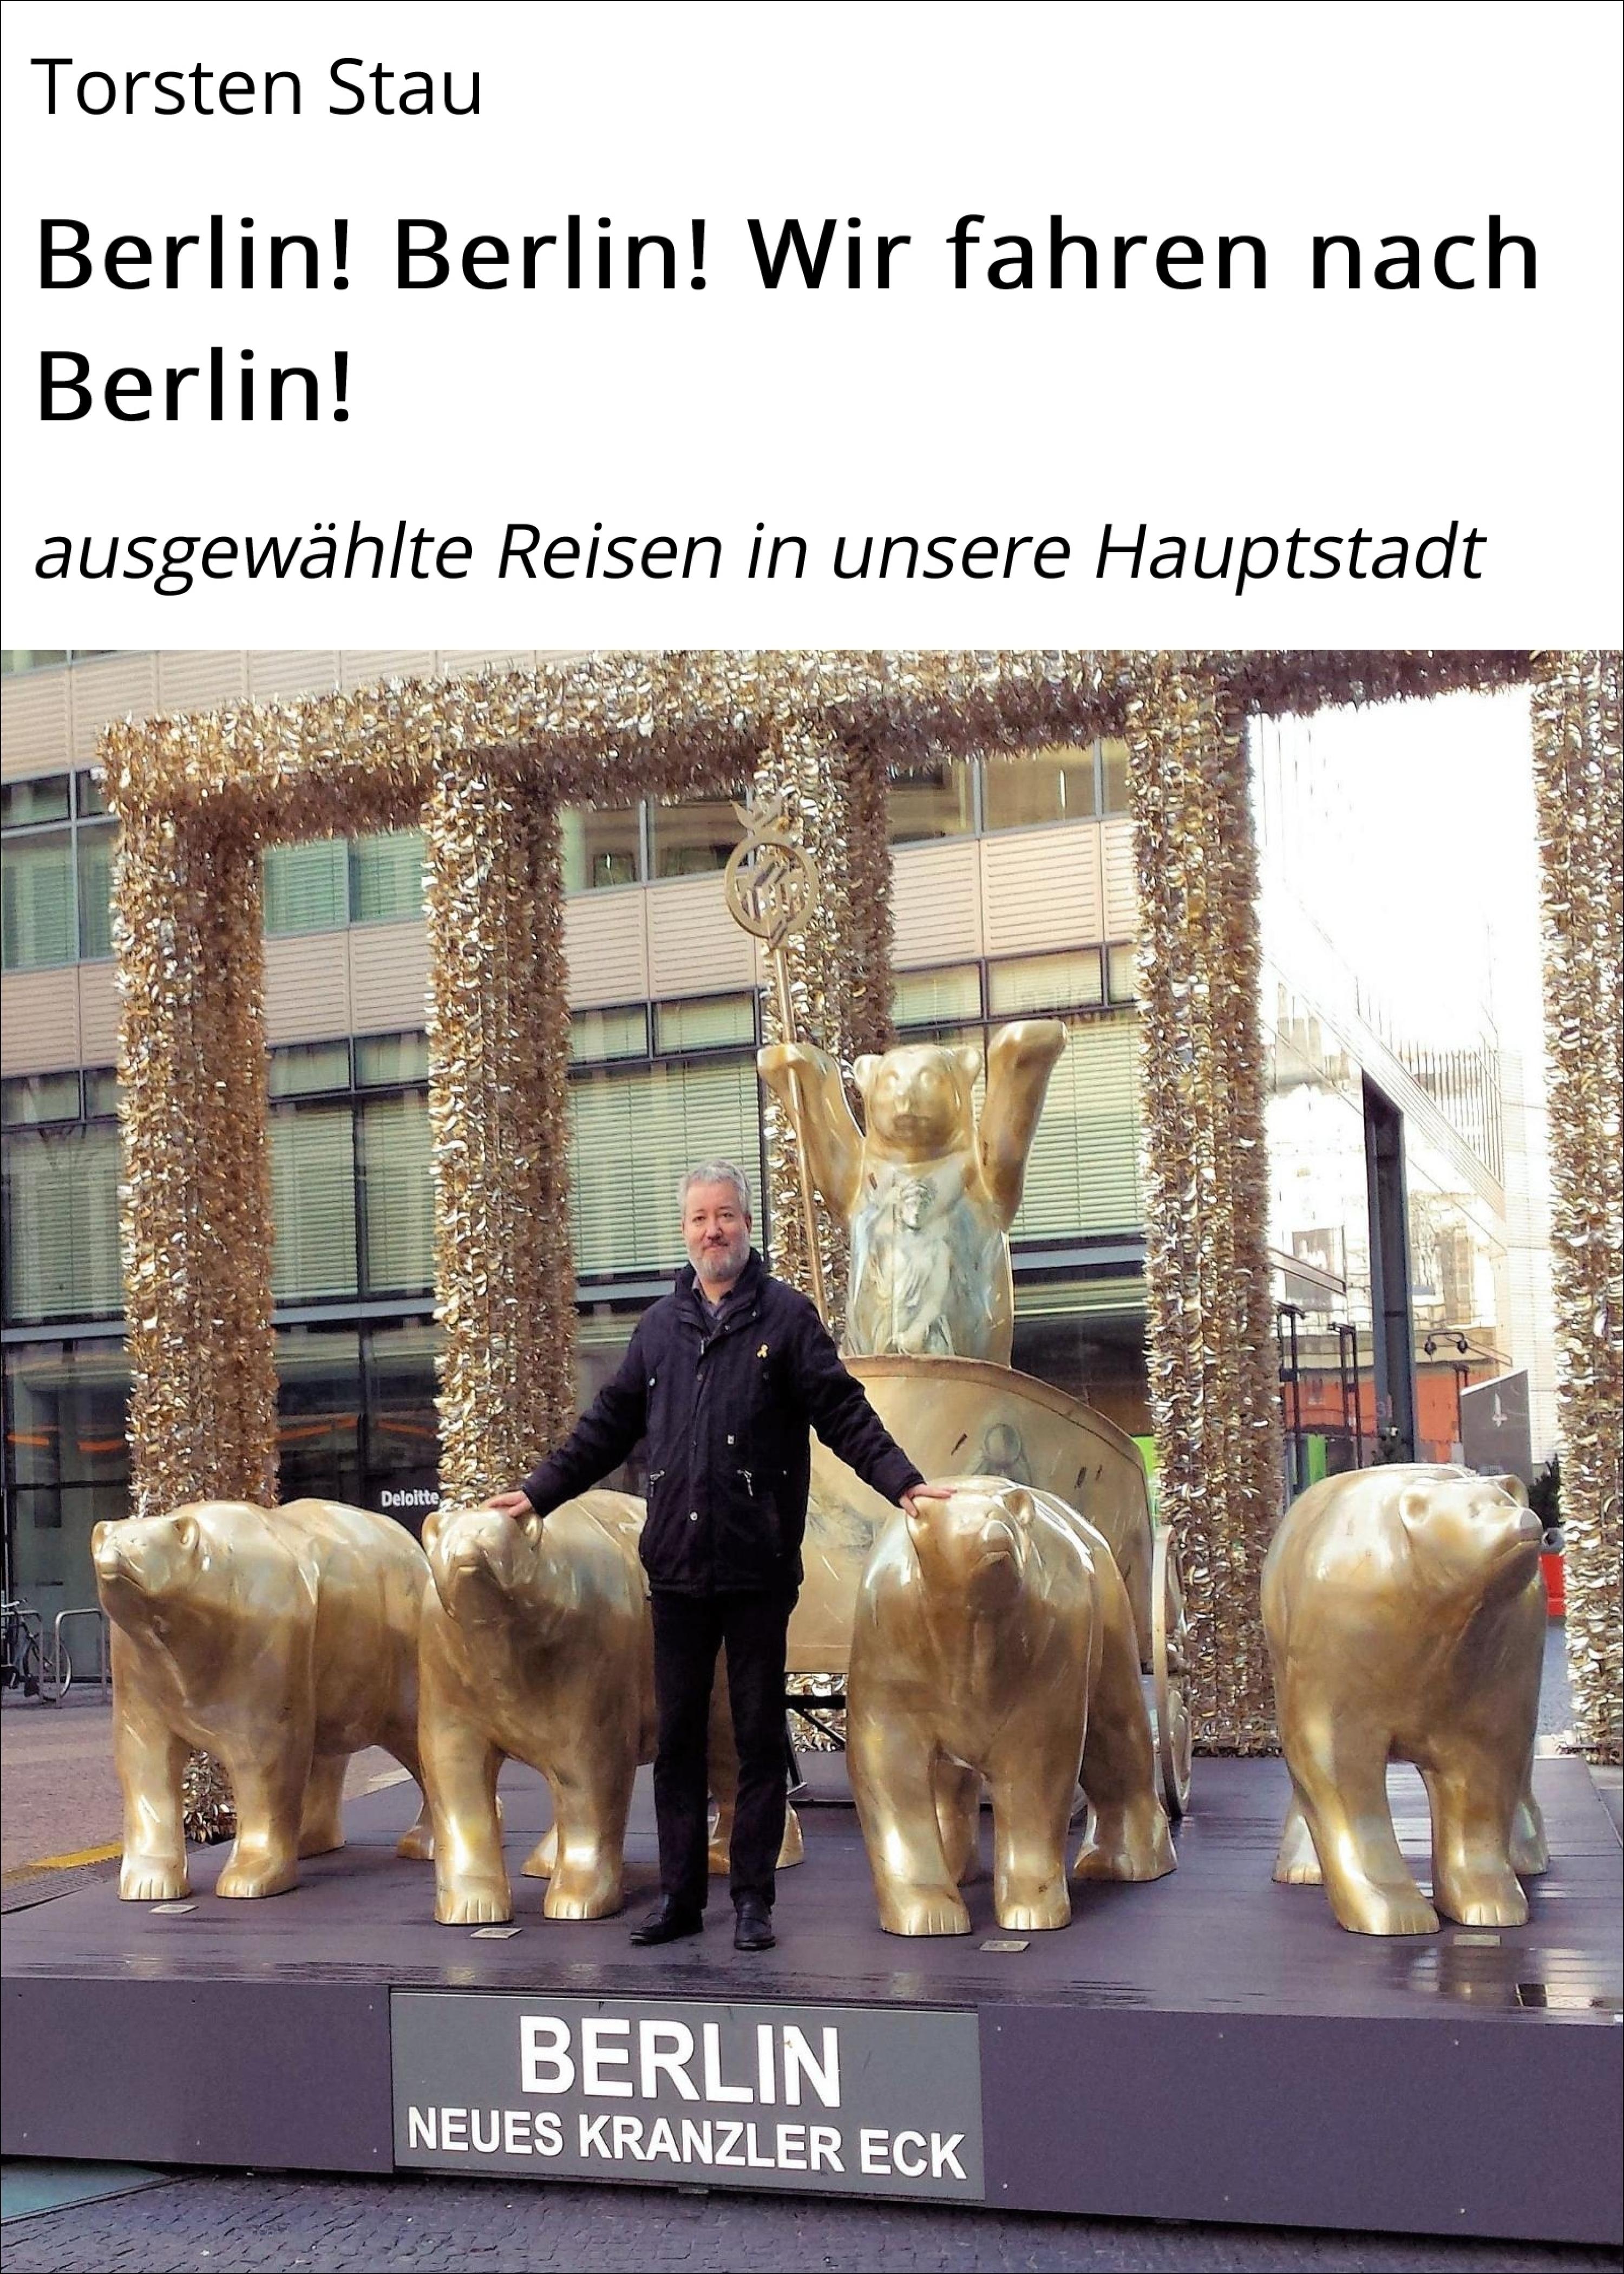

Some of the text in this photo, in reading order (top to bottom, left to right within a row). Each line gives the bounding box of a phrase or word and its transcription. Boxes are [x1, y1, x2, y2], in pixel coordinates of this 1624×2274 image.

[381, 1489, 440, 1507] Deloitte
[520, 2015, 841, 2107] BERLIN
[408, 2106, 967, 2180] NEUES KRANZLER ECK
